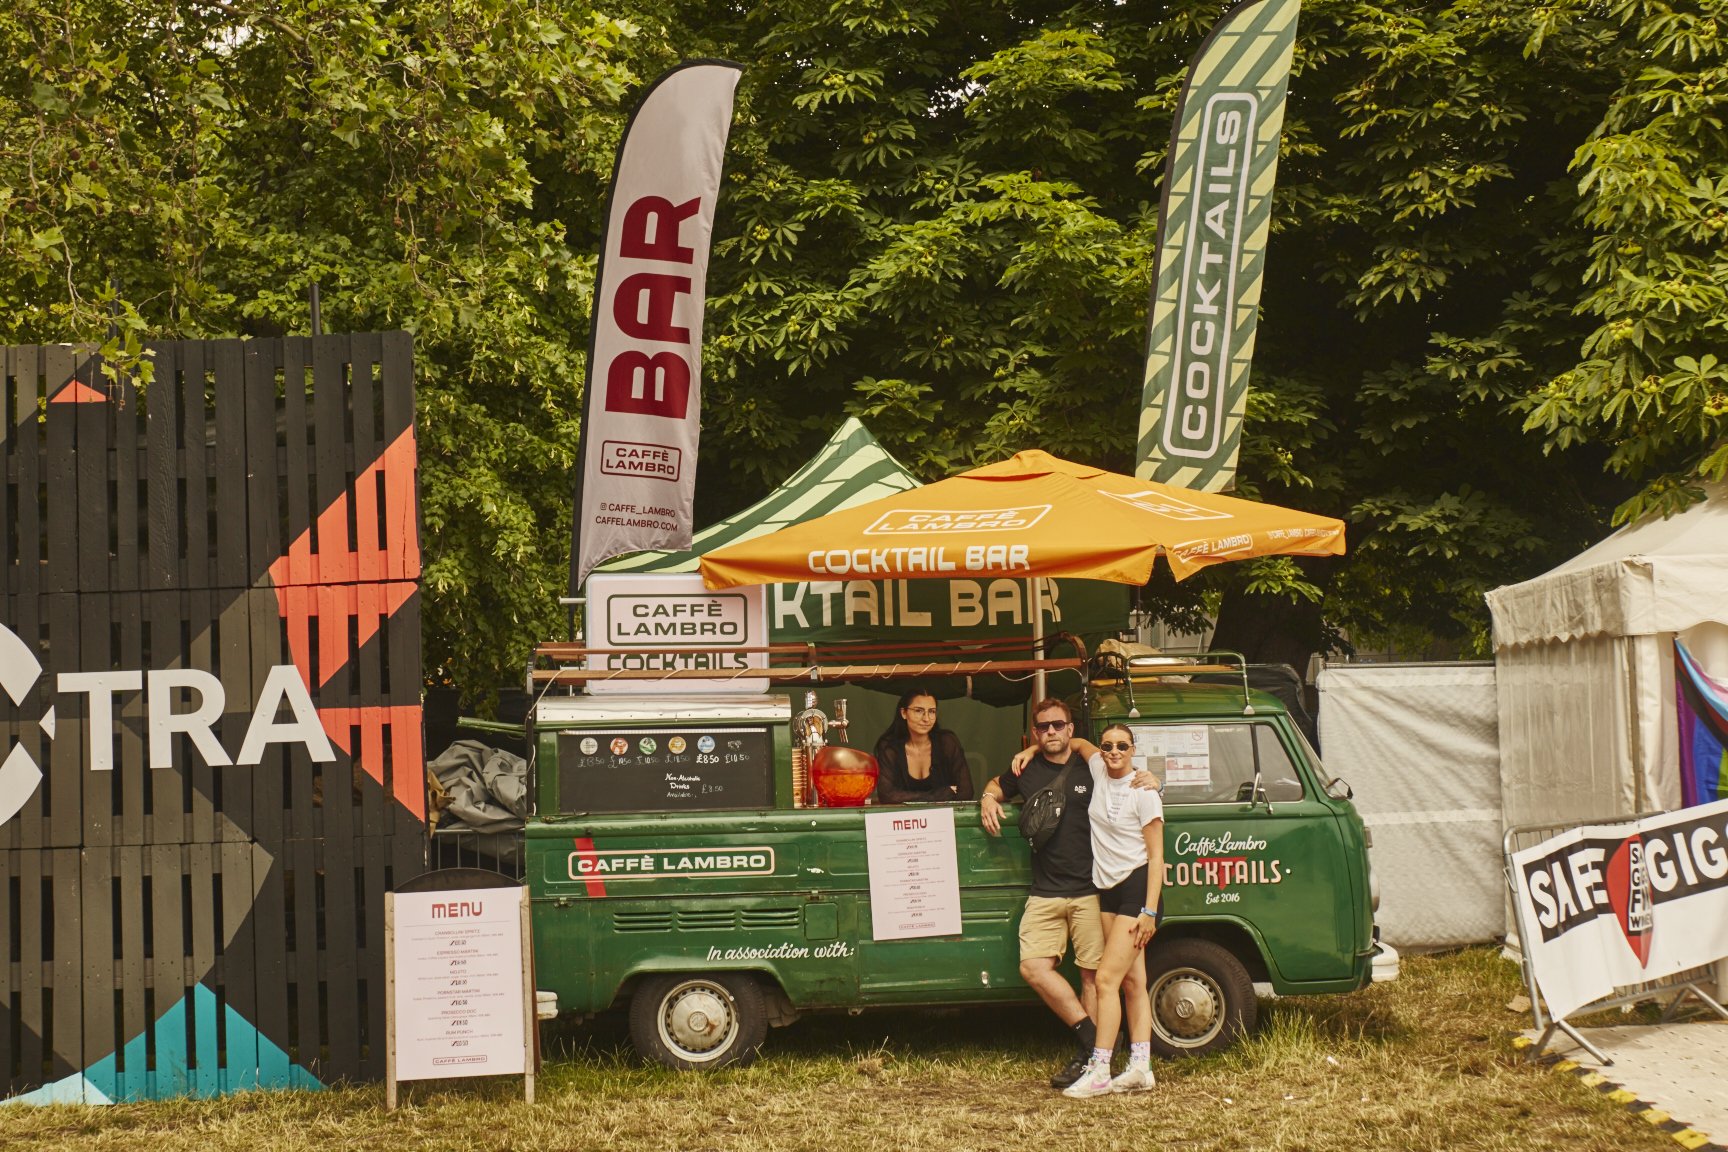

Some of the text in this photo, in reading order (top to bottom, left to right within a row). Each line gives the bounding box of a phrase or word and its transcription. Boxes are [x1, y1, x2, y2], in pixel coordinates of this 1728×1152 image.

[1181, 110, 1242, 440] COCKTAILS
[604, 195, 702, 420] BAR
[616, 448, 669, 461] CAFFÈ
[606, 459, 675, 475] LAMBRO
[608, 503, 676, 518] CAFFE_LAMBRO
[908, 510, 1019, 523] CAFFÈ
[595, 516, 678, 531] CAFFELAMBRO.COM
[878, 519, 1027, 531] LAMBRO
[1211, 534, 1250, 552] LAMBRO
[808, 545, 1031, 574] COCKTAIL BAR
[632, 600, 723, 617] CAFFÈ
[617, 622, 738, 636] LAMBRO
[607, 653, 749, 671] COCKTAILS
[893, 818, 928, 831] MENU
[1215, 831, 1267, 854] Lambro
[577, 854, 766, 873] CAFFÈ LAMBRO
[1163, 859, 1282, 886] COCKTAILS
[1221, 891, 1240, 903] 2016
[431, 901, 483, 918] MENU
[706, 945, 722, 961] In
[725, 942, 810, 960] association
